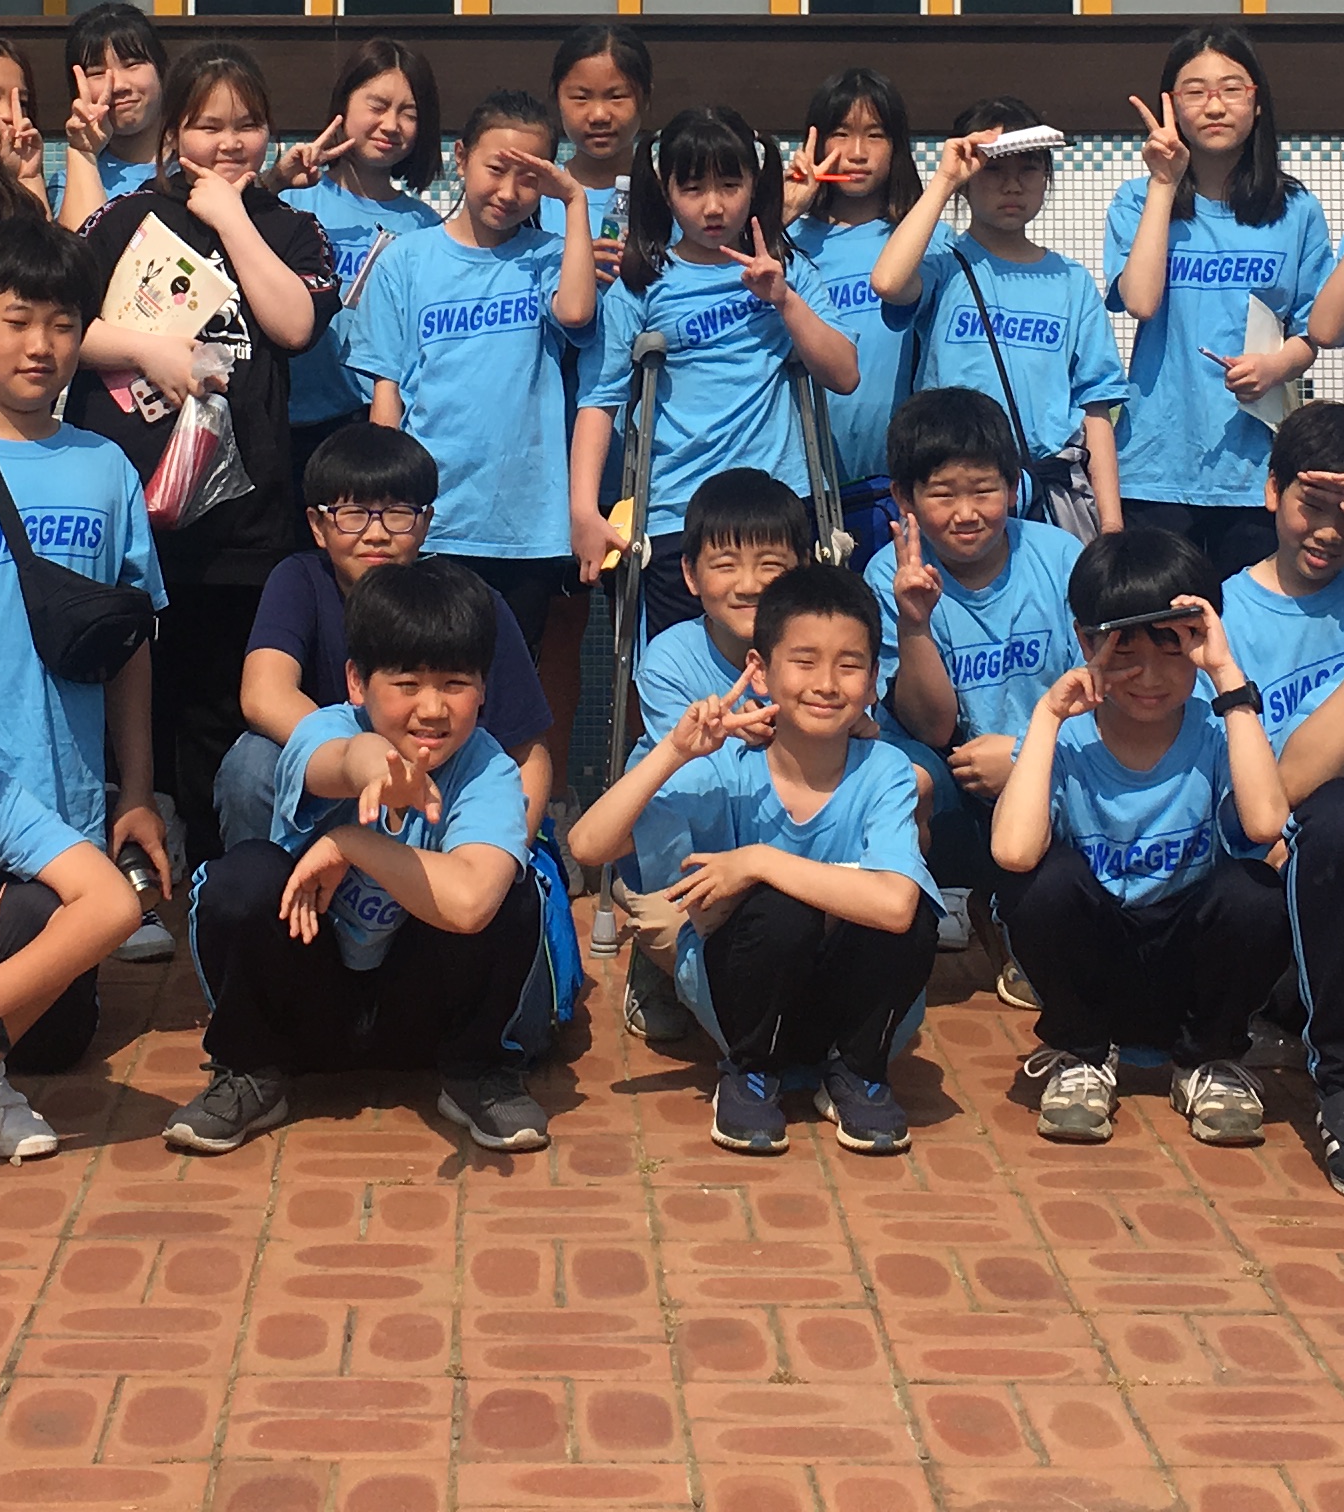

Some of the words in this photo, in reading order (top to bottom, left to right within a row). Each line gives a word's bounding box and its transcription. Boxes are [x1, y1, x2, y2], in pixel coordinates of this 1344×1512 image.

[1168, 255, 1277, 284] WAGGERS
[422, 294, 539, 339] SWAGGERS
[685, 293, 771, 346] SWAGG
[953, 639, 1041, 686] WAGGERS
